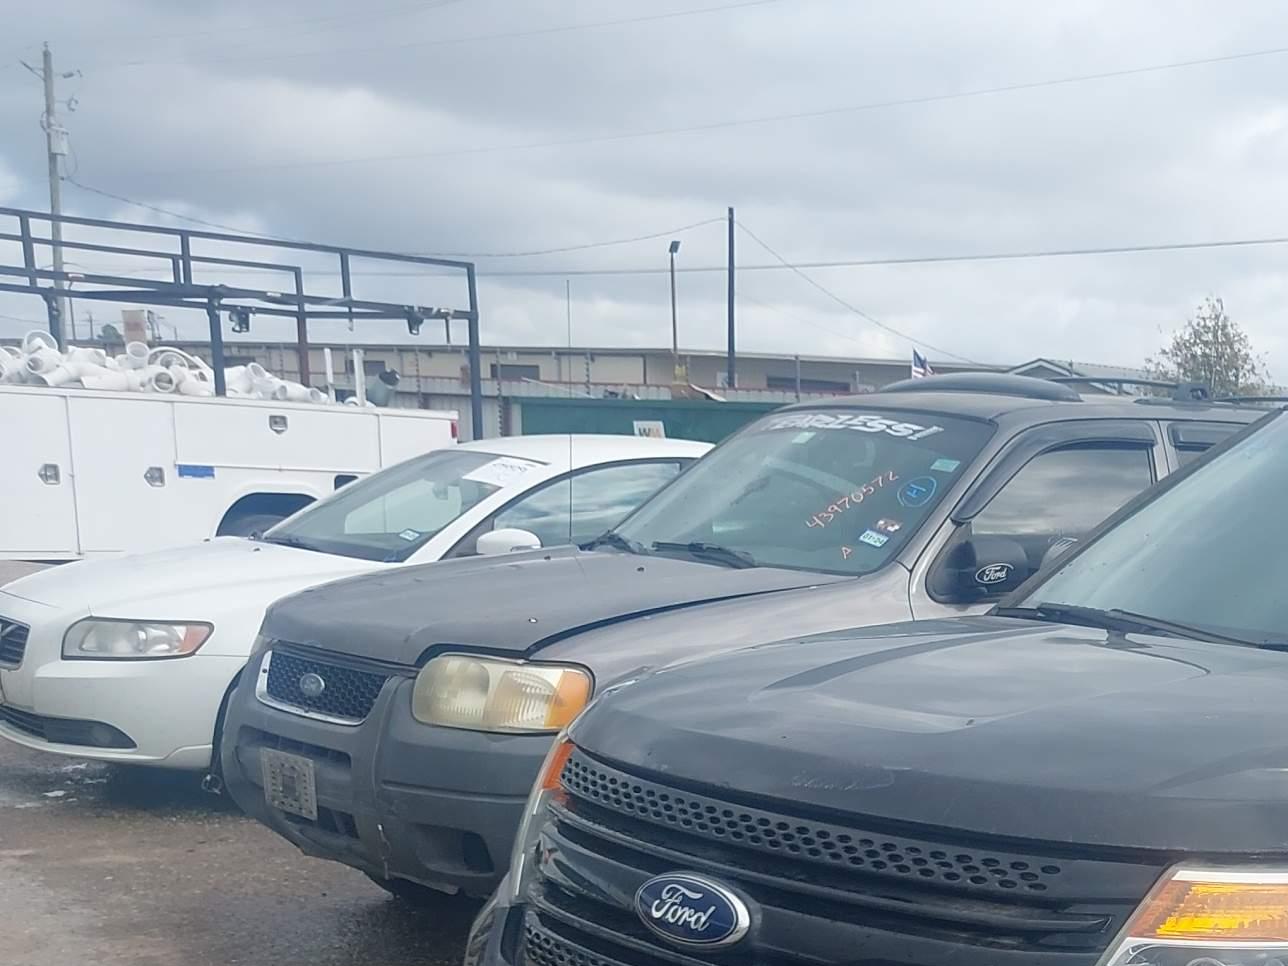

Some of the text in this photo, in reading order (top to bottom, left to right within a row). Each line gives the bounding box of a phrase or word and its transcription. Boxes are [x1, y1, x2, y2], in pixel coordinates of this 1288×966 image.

[805, 471, 899, 529] 43970572
[983, 566, 1008, 581] Ford
[651, 883, 717, 932] Ford
